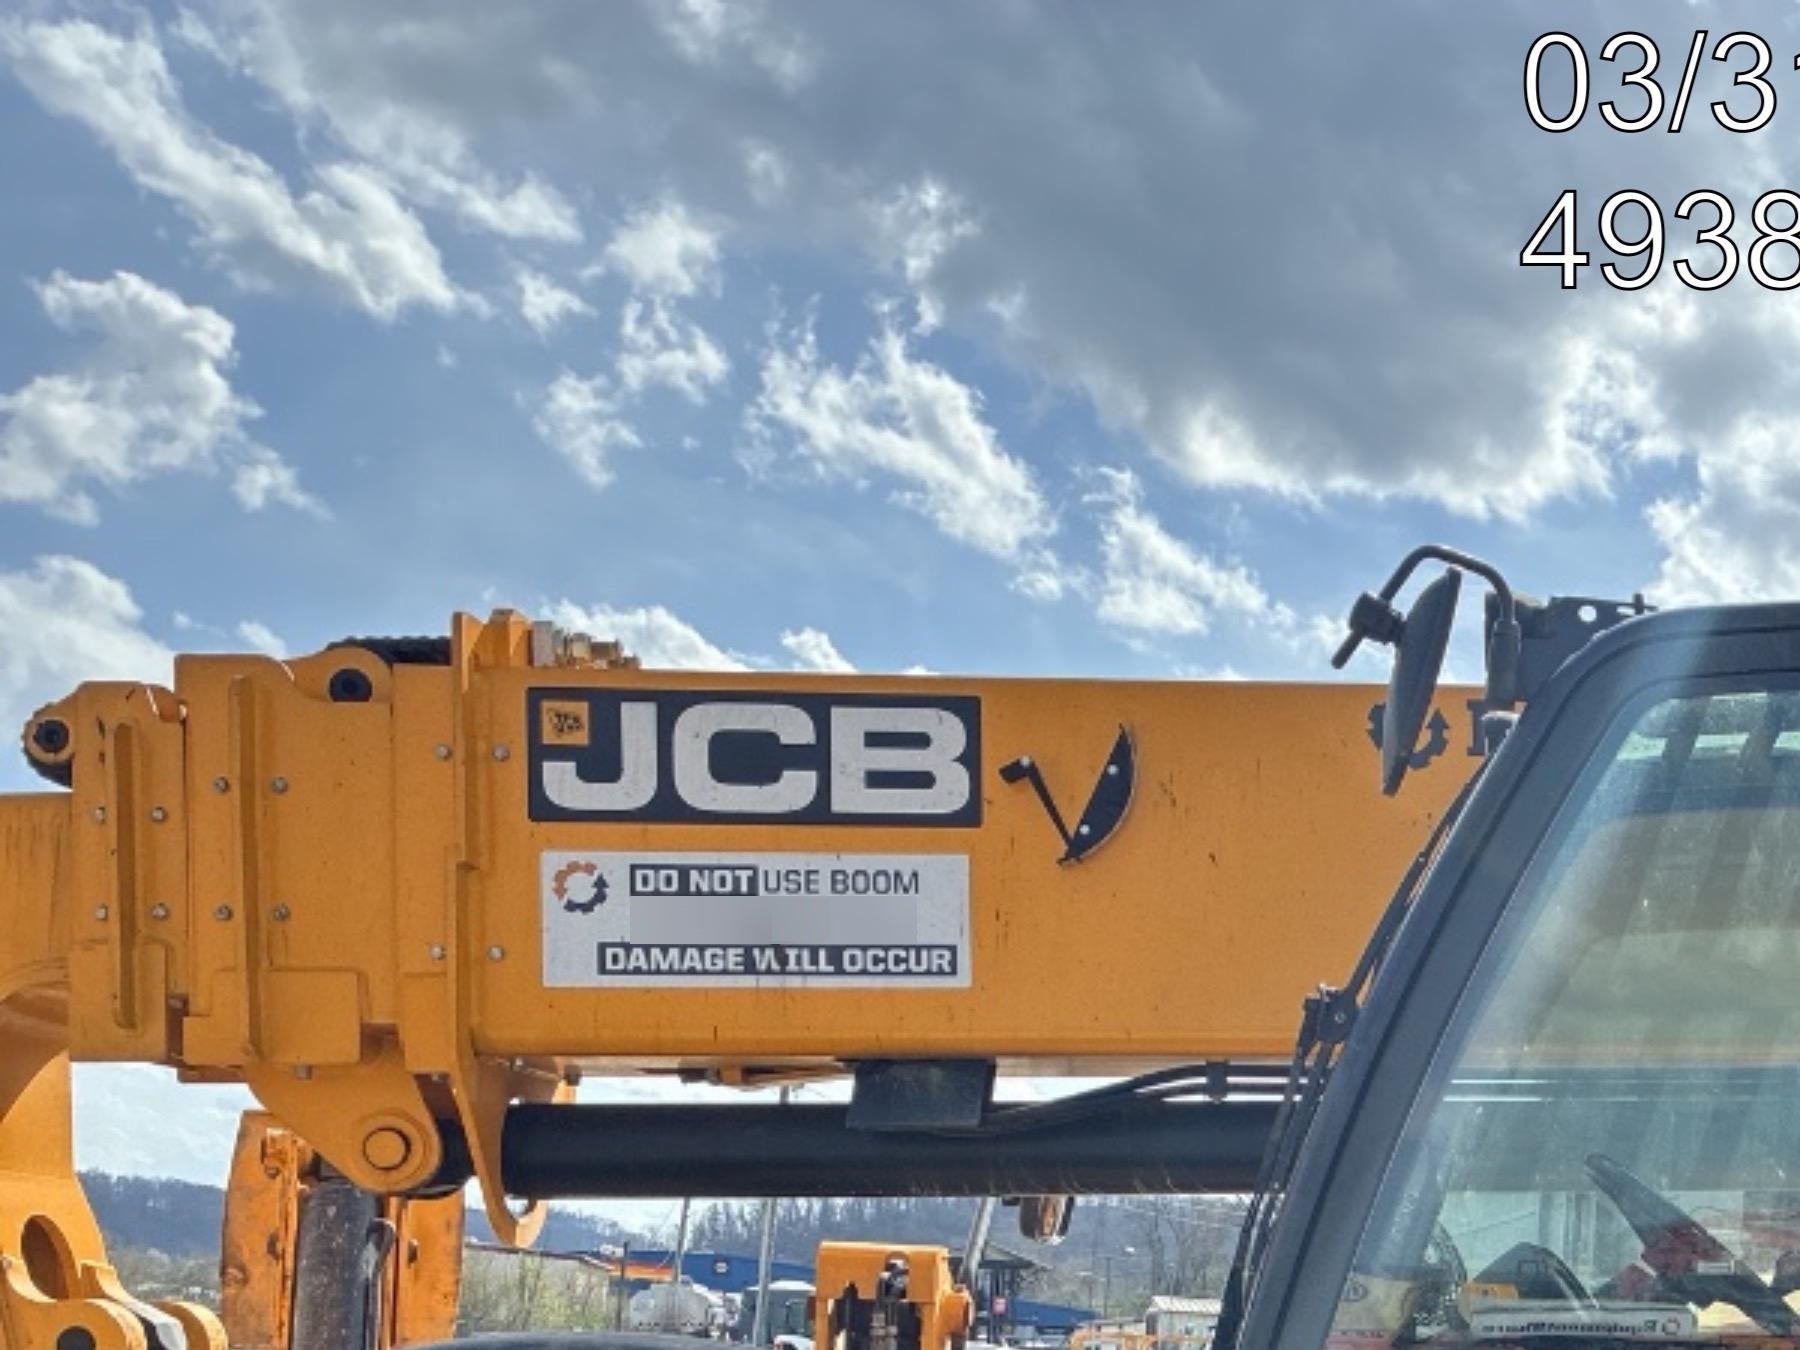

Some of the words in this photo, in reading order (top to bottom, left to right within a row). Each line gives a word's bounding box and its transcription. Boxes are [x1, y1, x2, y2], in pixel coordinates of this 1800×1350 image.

[542, 700, 971, 814] JCB
[634, 868, 680, 893] DO
[689, 868, 754, 894] NOT
[764, 869, 820, 895] USE
[830, 870, 919, 895] BOOM
[604, 947, 745, 972] DAMAGE
[752, 947, 834, 972] WILL
[842, 948, 952, 974] OCCUR
